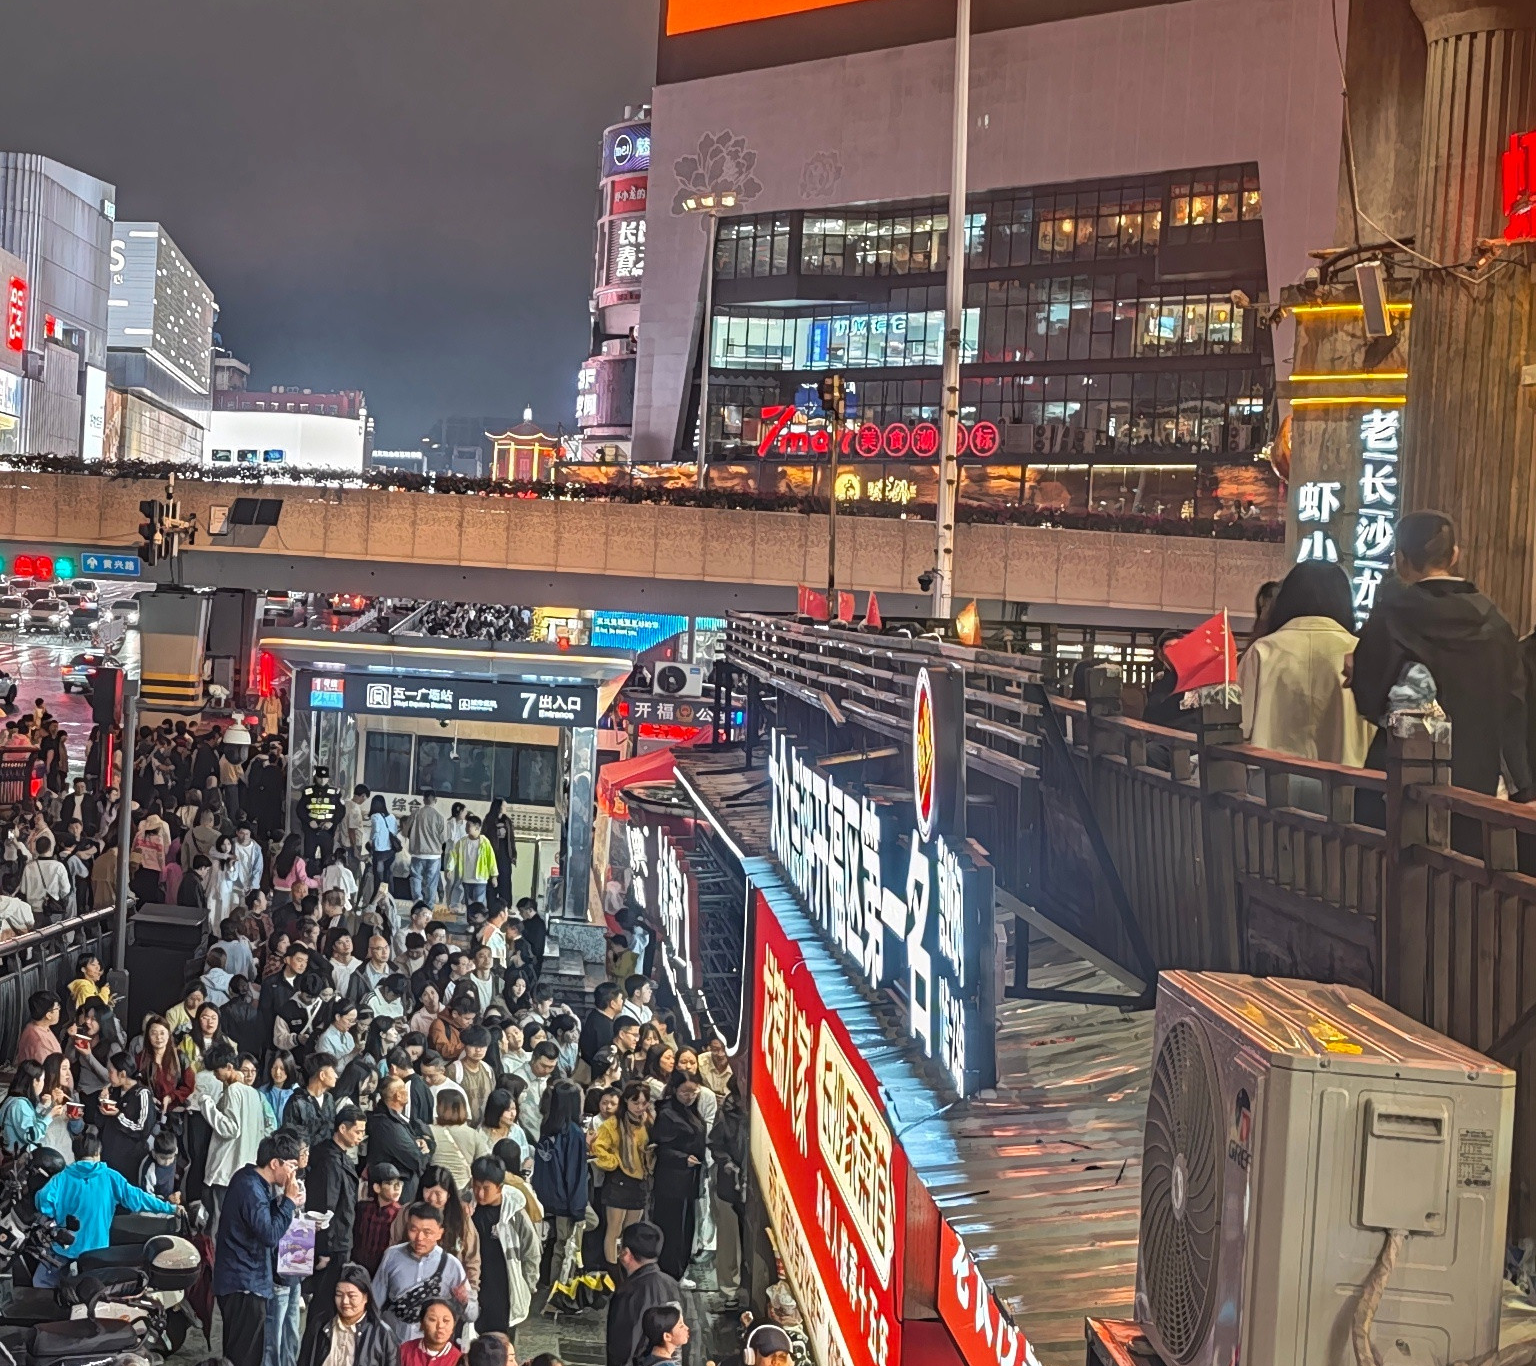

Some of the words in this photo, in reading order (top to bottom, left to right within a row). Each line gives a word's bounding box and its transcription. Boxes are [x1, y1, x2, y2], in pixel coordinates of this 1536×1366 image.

[103, 559, 135, 571] 黄兴路
[392, 687, 454, 703] 五一广场站
[538, 695, 581, 711] 出入口
[519, 692, 537, 719] 7
[634, 702, 674, 721] 开福
[819, 1065, 893, 1257] 长沙家菜馆
